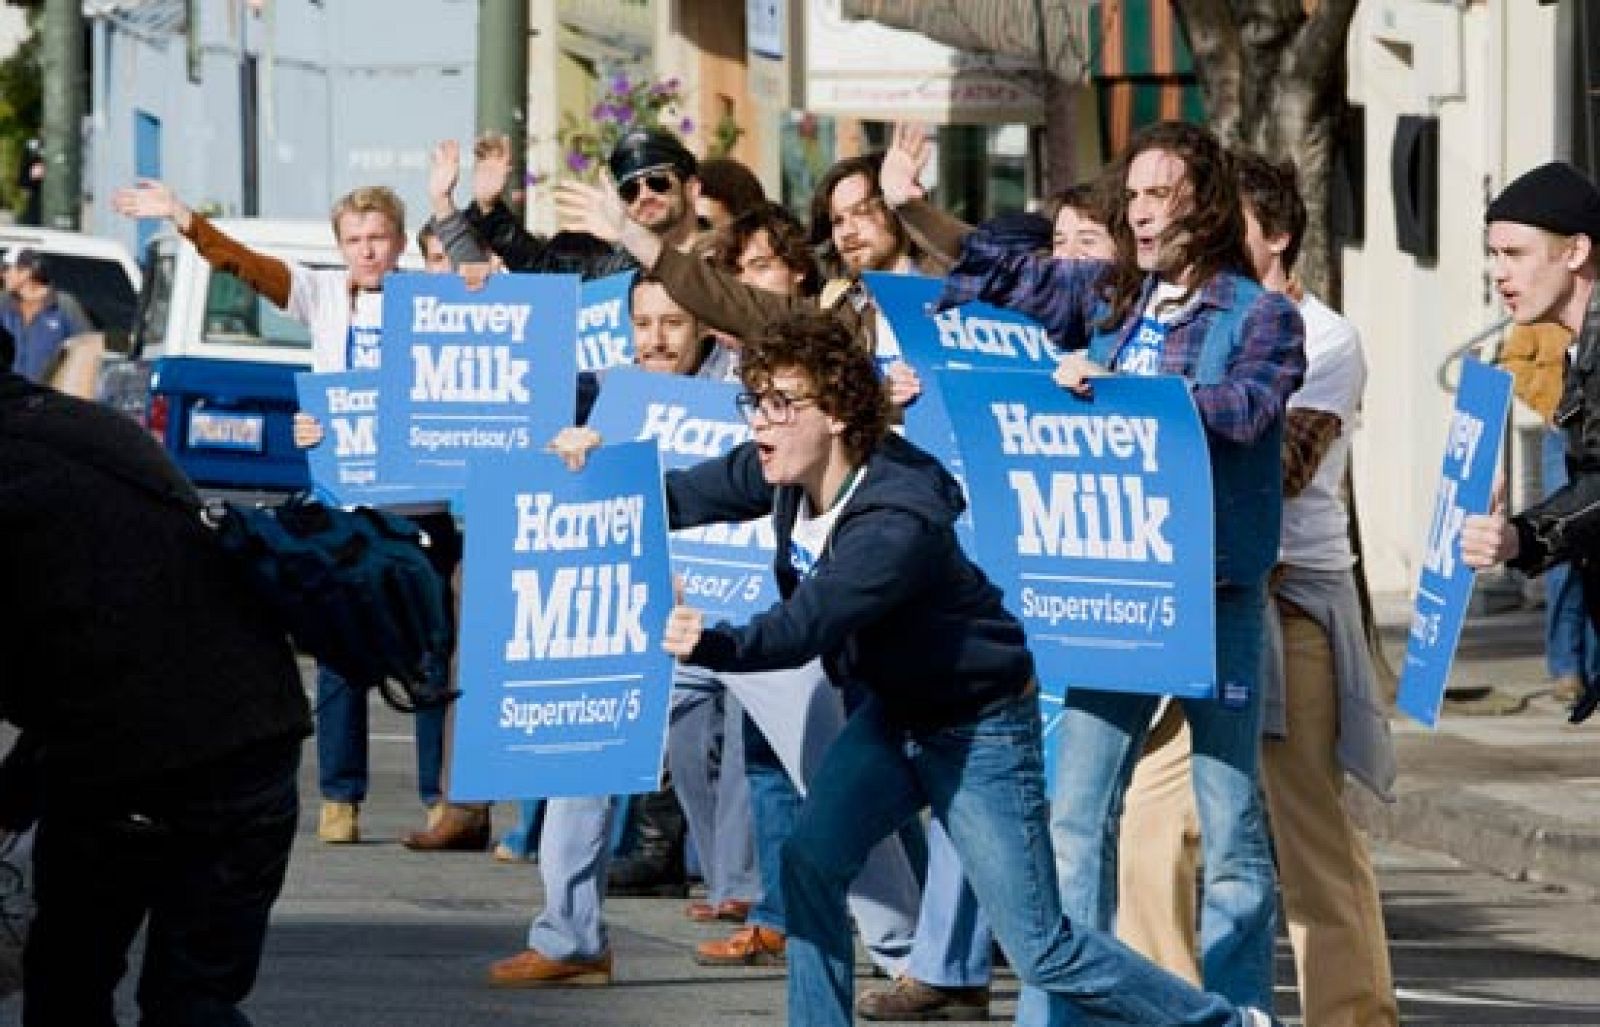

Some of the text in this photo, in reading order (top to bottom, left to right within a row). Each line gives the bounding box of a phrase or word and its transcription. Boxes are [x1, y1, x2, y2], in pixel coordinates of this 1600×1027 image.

[412, 296, 531, 342] Harvey
[410, 344, 530, 402] Milk
[409, 426, 530, 453] Supervisor/5
[989, 403, 1158, 472] Harvey
[514, 491, 644, 557] Harvey
[1008, 470, 1174, 563] Milk
[505, 563, 648, 661] Milk
[1021, 587, 1175, 633] Supervisor/5
[500, 688, 641, 735] Supervisor/5
